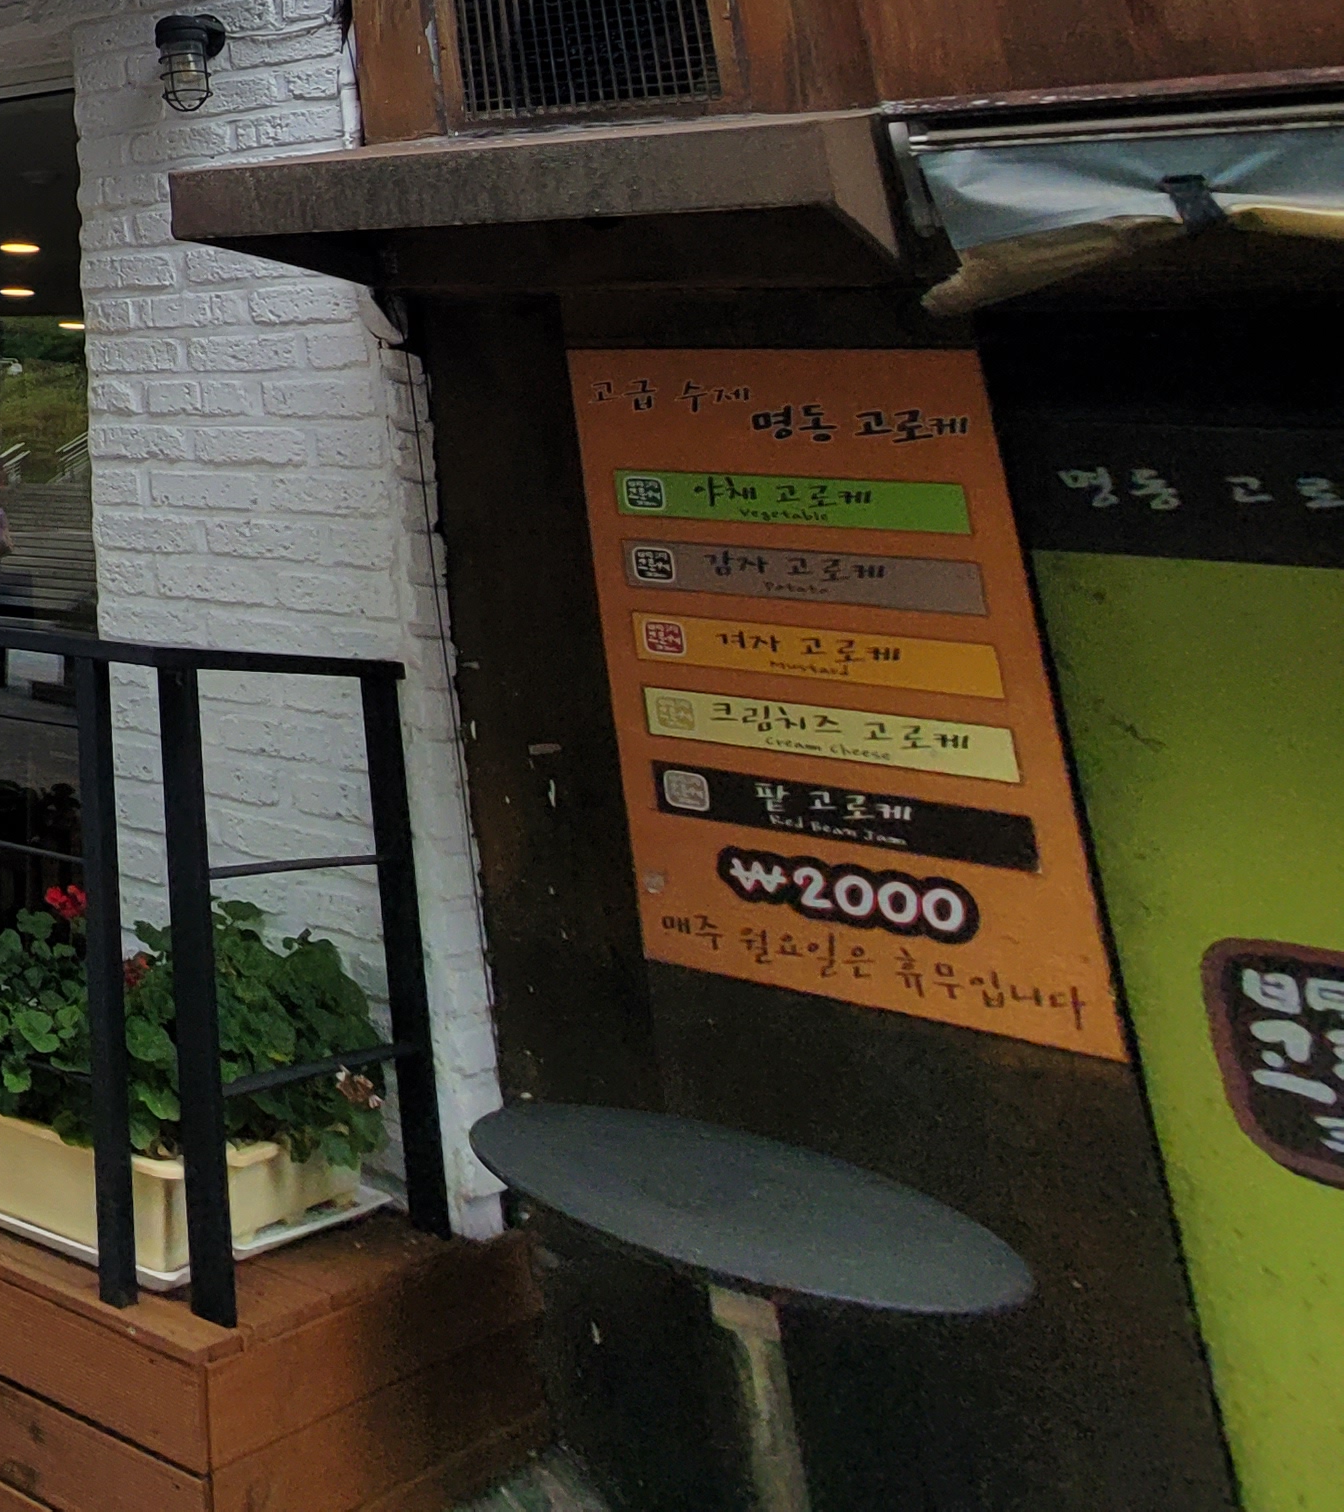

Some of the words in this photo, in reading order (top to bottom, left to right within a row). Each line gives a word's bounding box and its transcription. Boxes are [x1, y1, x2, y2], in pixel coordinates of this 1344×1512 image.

[676, 380, 750, 413] 수제
[751, 404, 839, 443] 명동
[853, 409, 970, 443] 고로케
[693, 477, 758, 508] 야채
[775, 484, 873, 508] 고로케
[1057, 465, 1183, 510] 명동
[704, 550, 769, 577] 감자
[787, 557, 887, 582] 고로케
[800, 637, 901, 663] 고로케
[710, 701, 843, 734] 크림치즈
[864, 722, 970, 751] 고로케
[755, 782, 789, 813] 팥
[809, 791, 912, 821] 고로케
[661, 915, 723, 951] 매주
[740, 928, 875, 981] 월요일은
[895, 947, 1087, 1032] 휴무입니다
